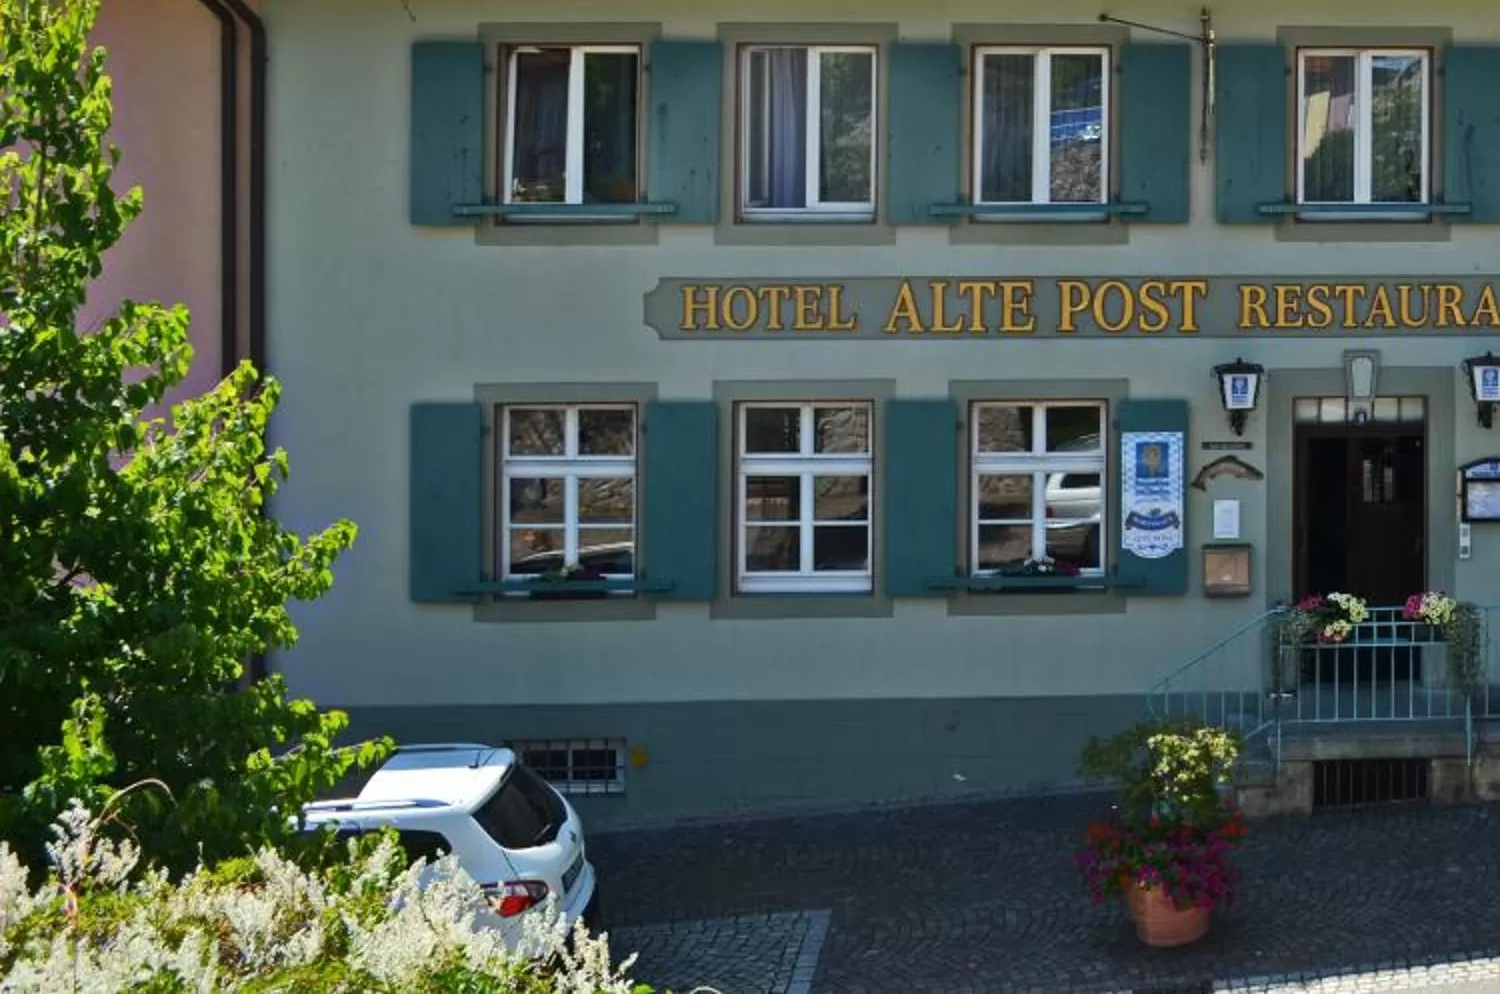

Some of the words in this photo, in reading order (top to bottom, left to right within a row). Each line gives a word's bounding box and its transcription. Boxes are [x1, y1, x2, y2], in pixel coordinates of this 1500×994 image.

[680, 284, 858, 332] HOTEL
[883, 279, 1037, 335] ALTE
[1055, 278, 1209, 334] POST
